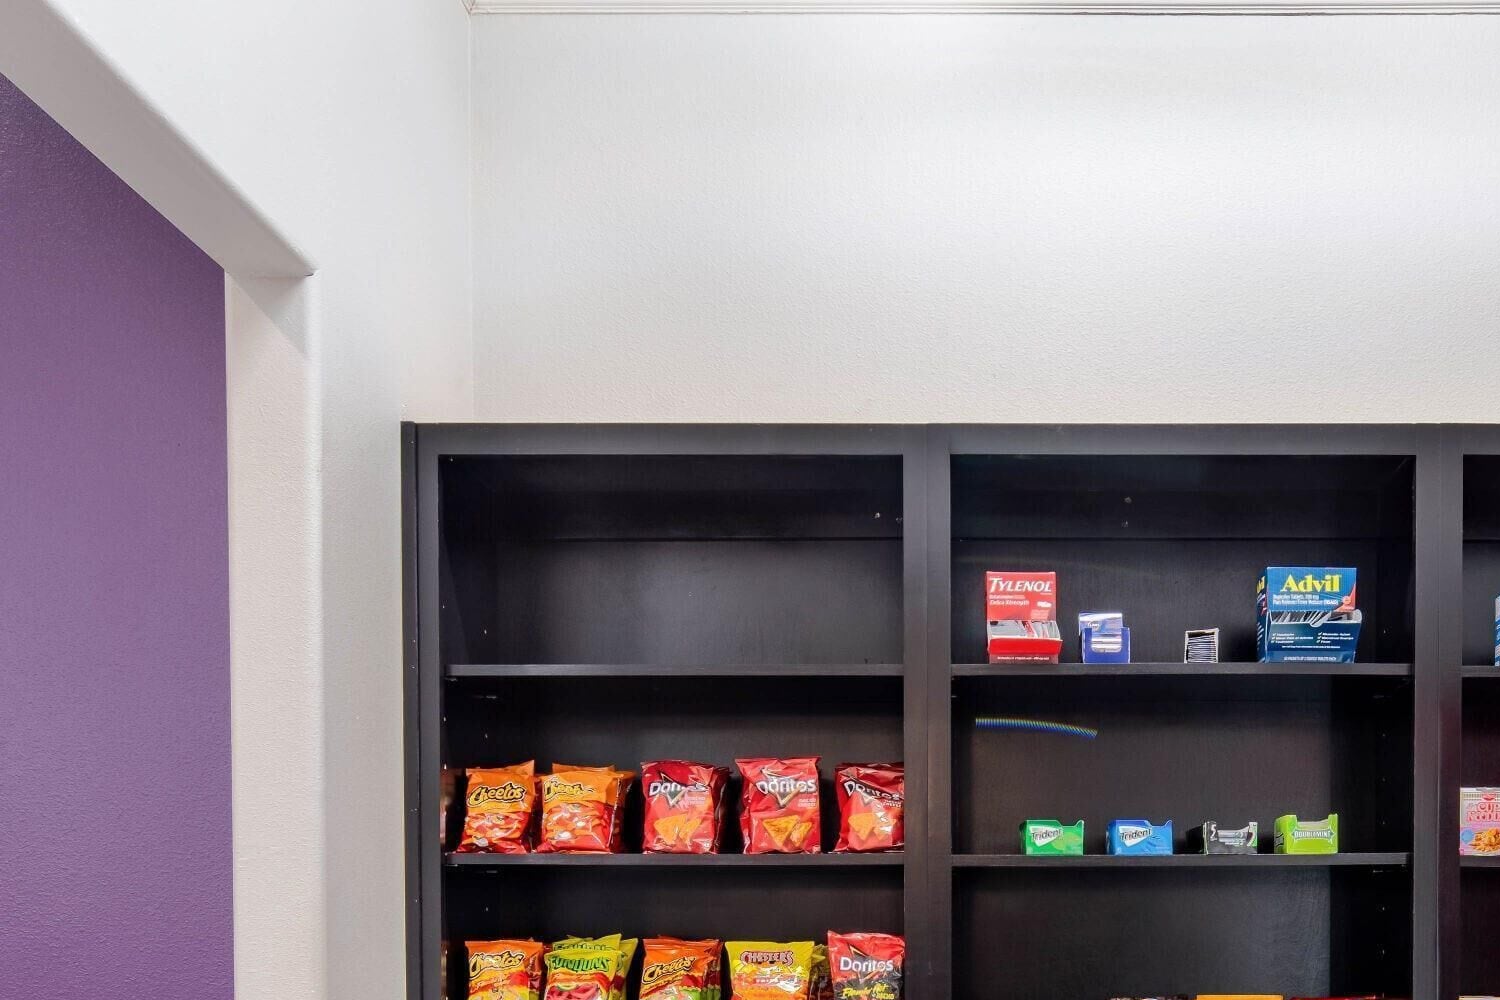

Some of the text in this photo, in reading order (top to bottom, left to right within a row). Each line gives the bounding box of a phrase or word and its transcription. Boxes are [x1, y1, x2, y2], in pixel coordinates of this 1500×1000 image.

[988, 578, 1052, 593] TYLENOL
[1280, 574, 1340, 592] Advil
[469, 783, 525, 806] Cheetos
[756, 776, 817, 795] Doritos
[844, 781, 901, 800] Doritos
[1031, 828, 1062, 841] Trident
[1119, 828, 1152, 841] Trident
[1294, 830, 1332, 839] DOUBLEMINT
[551, 955, 610, 973] FUNYUNS
[641, 956, 697, 983] Cheetos
[839, 956, 894, 972] Doritos
